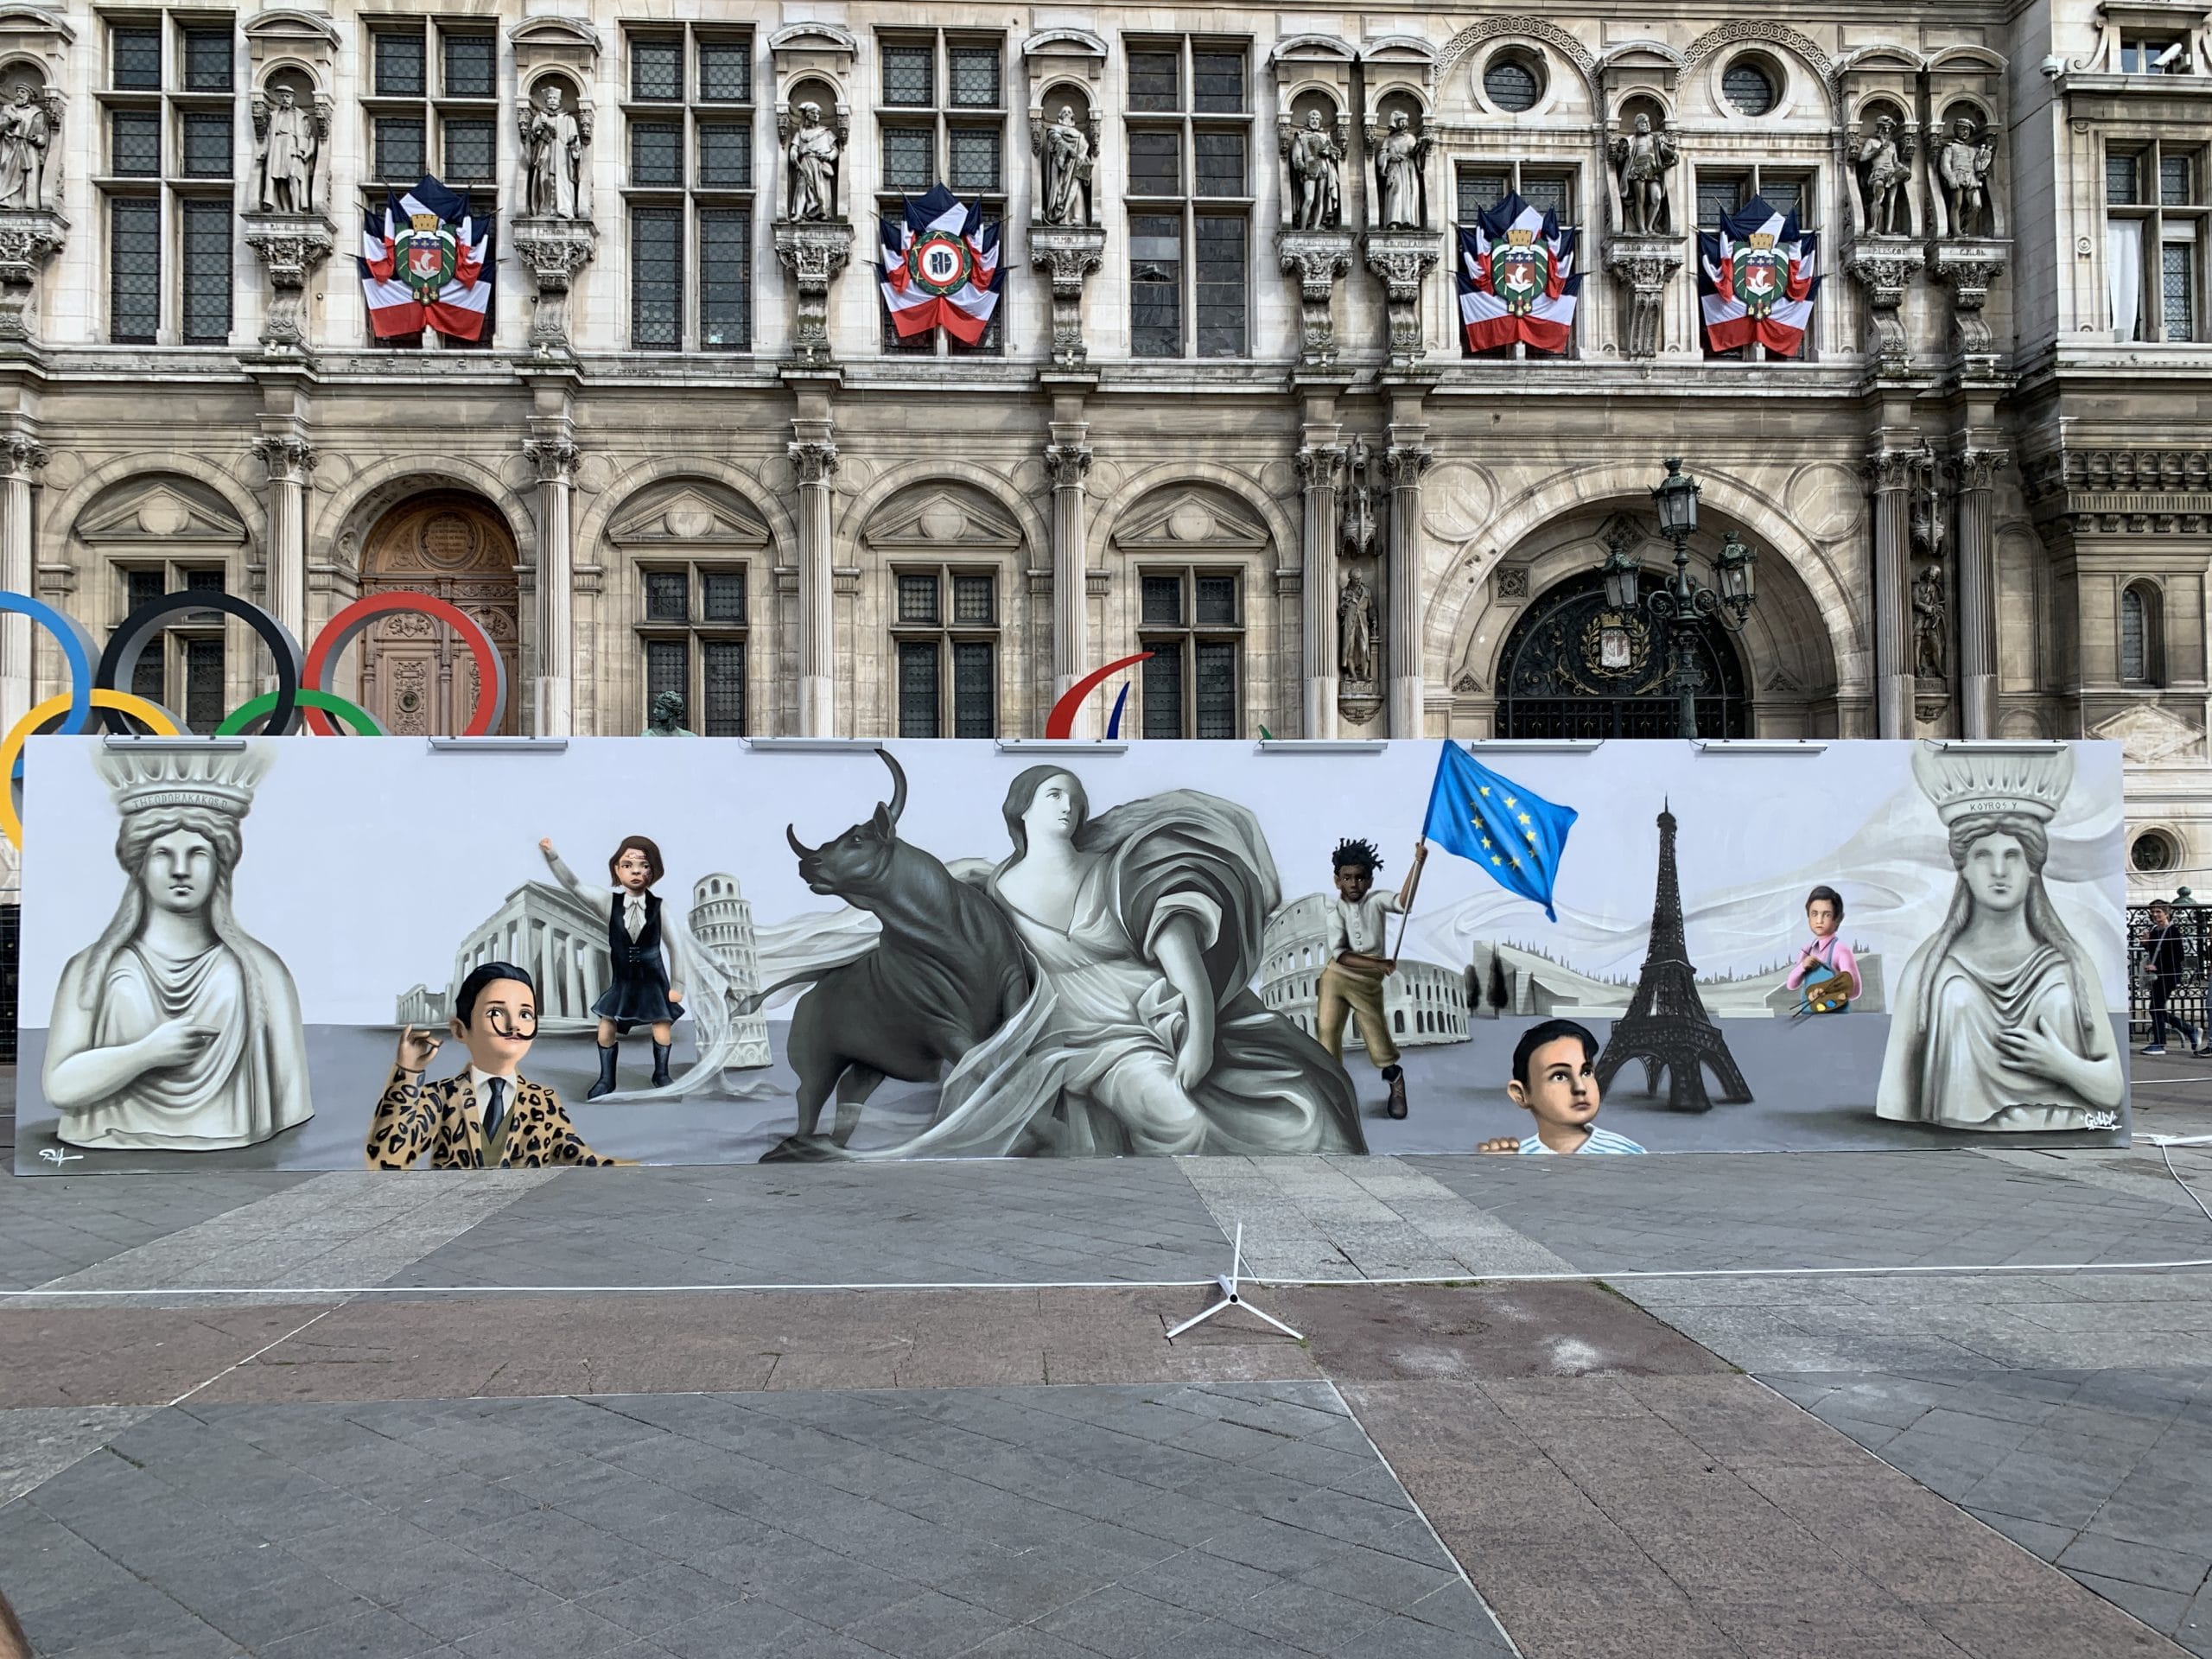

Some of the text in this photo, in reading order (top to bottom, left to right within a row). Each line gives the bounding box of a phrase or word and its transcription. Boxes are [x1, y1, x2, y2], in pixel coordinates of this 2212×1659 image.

[930, 251, 953, 275] RF
[131, 793, 219, 809] THEODORAKAKOS
[1970, 801, 2006, 810] KOYROS
